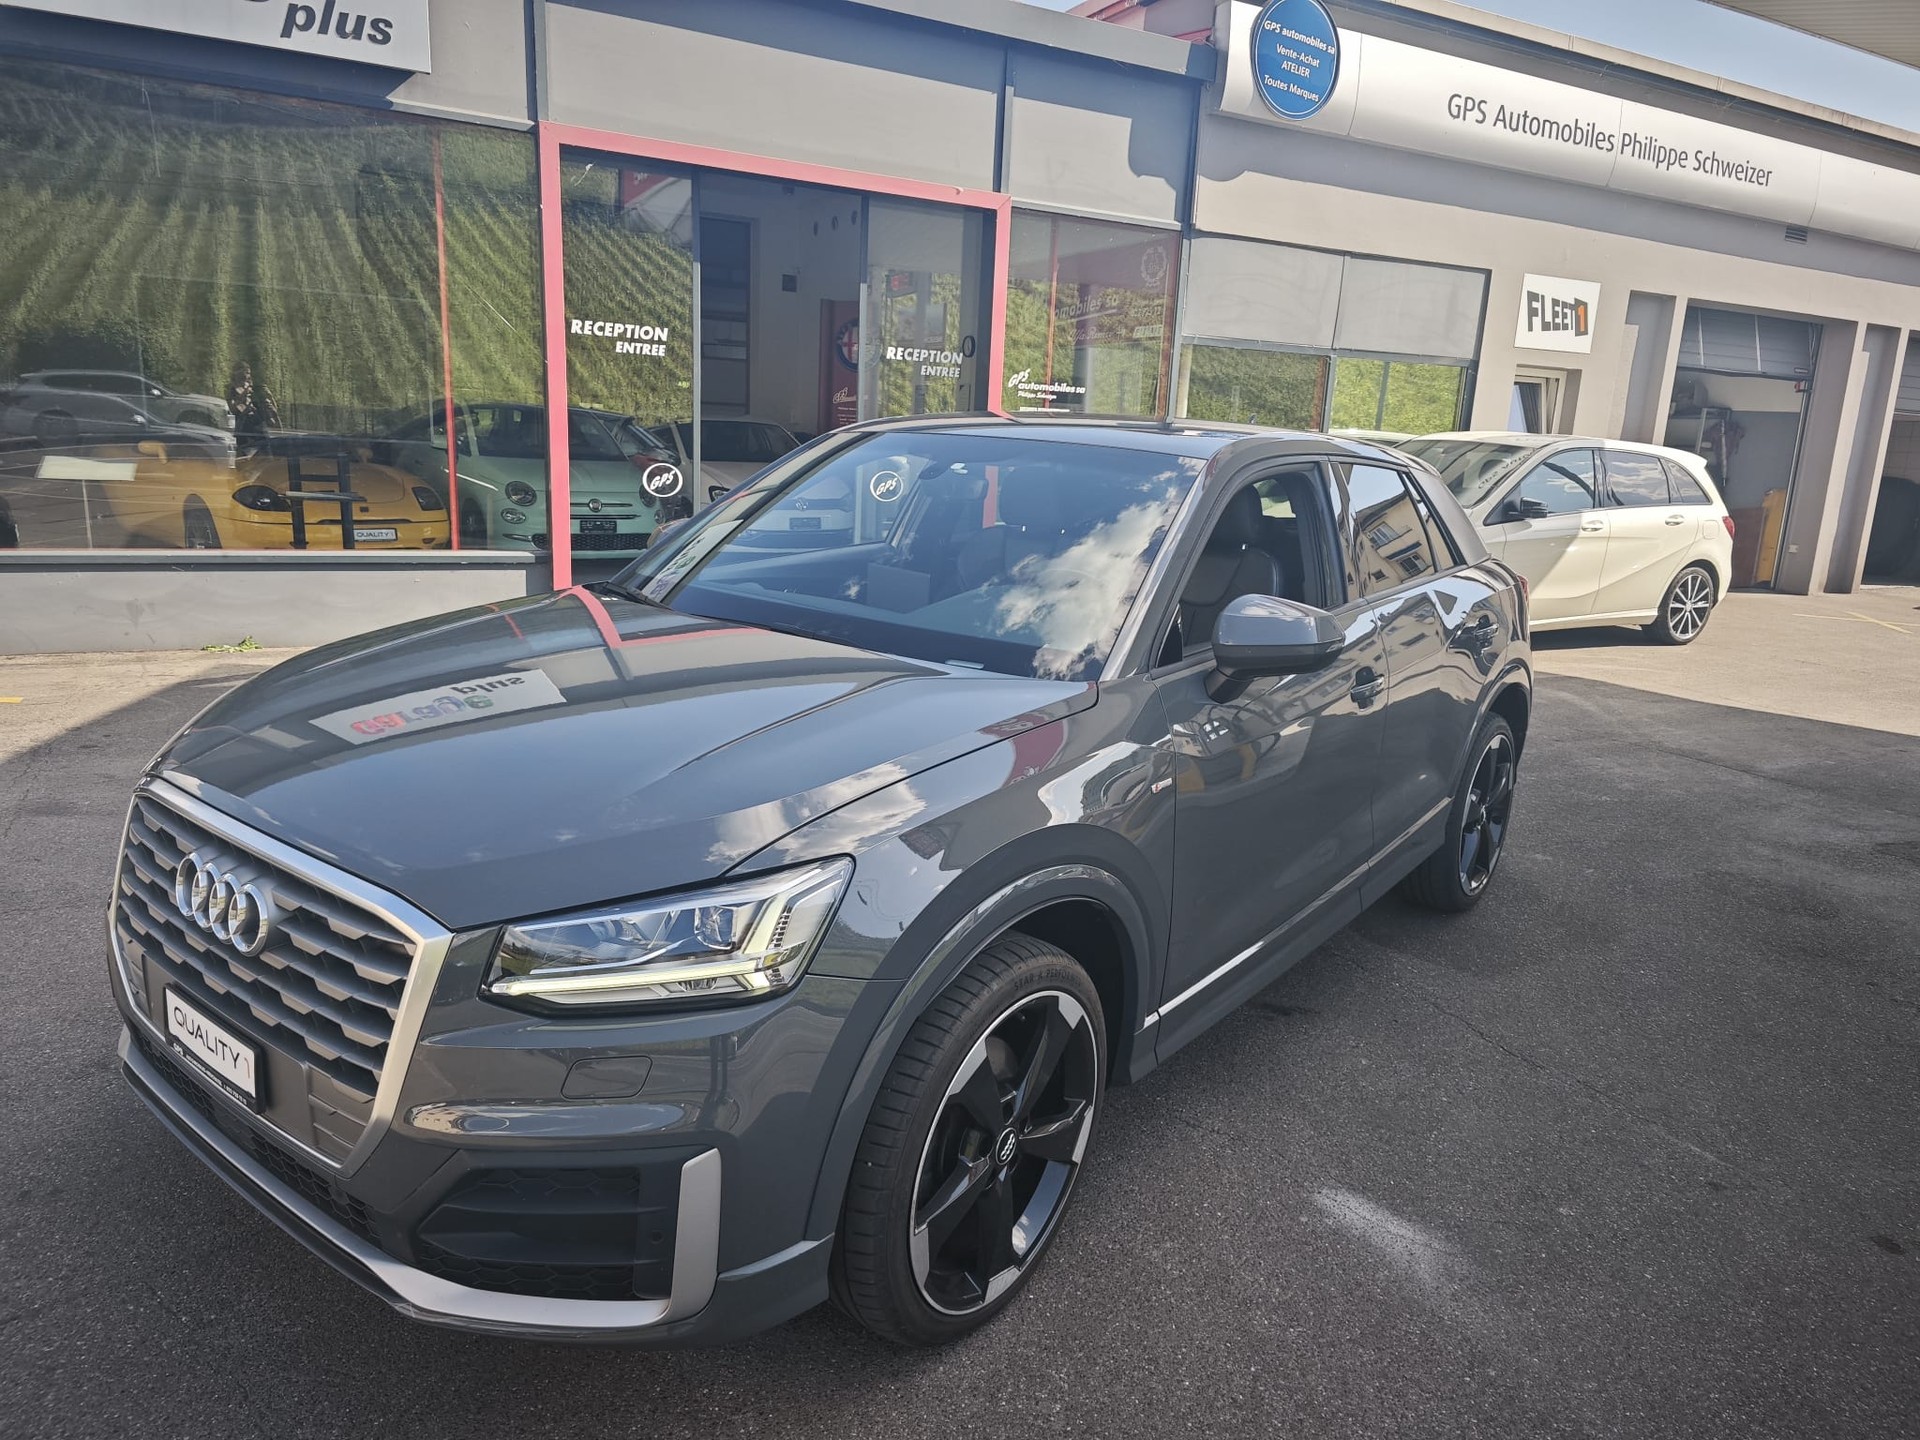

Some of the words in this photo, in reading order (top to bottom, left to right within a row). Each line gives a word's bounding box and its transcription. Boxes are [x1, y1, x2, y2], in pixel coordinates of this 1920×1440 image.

[280, 0, 394, 46] plus
[1264, 20, 1281, 33] GPS
[1282, 27, 1327, 51] automobiles
[1327, 45, 1335, 55] sa
[1276, 43, 1320, 67] Vente-Achat
[1281, 61, 1310, 78] ATELIER
[1264, 74, 1287, 91] Toutes
[1289, 83, 1319, 101] Marques
[1447, 92, 1488, 124] GPS
[1492, 104, 1615, 153] Automobiles
[1620, 132, 1688, 171] Philippe
[1692, 149, 1772, 187] Schweizer
[571, 319, 669, 341] RECEPTION
[616, 341, 667, 357] ENTREE
[886, 346, 963, 364] RECEPTION
[920, 365, 961, 378] ENTREE
[1008, 368, 1031, 388] GPS
[1018, 382, 1075, 393] automobiles
[1075, 386, 1086, 394] sa
[650, 469, 675, 491] GPS
[876, 477, 898, 496] GPS
[173, 1006, 240, 1069] QUALITY
